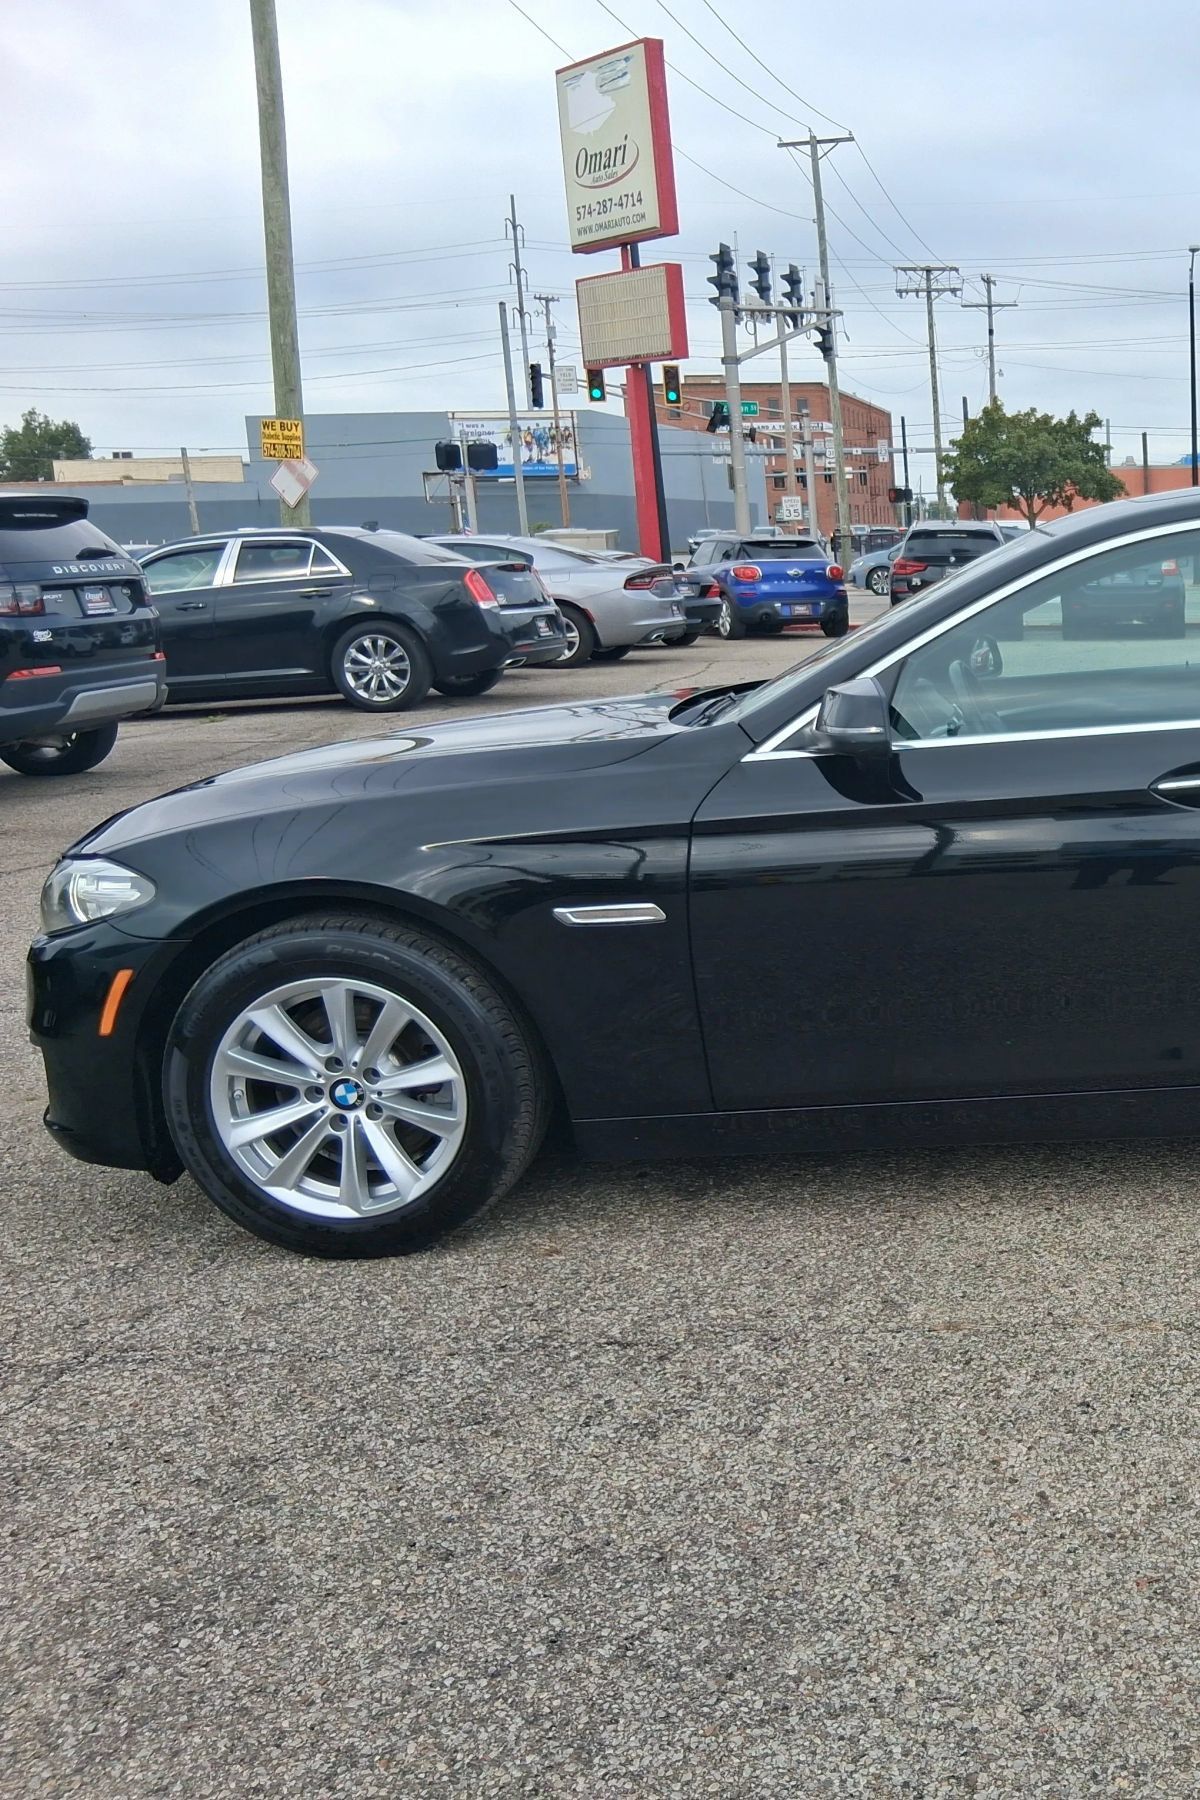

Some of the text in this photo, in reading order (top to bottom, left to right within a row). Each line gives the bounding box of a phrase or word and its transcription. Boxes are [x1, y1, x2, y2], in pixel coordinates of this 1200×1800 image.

[575, 133, 629, 179] Omari
[604, 169, 619, 182] Sales
[575, 190, 643, 222] 574-287-4714
[576, 212, 646, 237] WWW.OMARIAUTO.COM
[262, 420, 300, 432] WE BUY
[785, 508, 801, 517] 35
[52, 562, 127, 574] DISCOVERY
